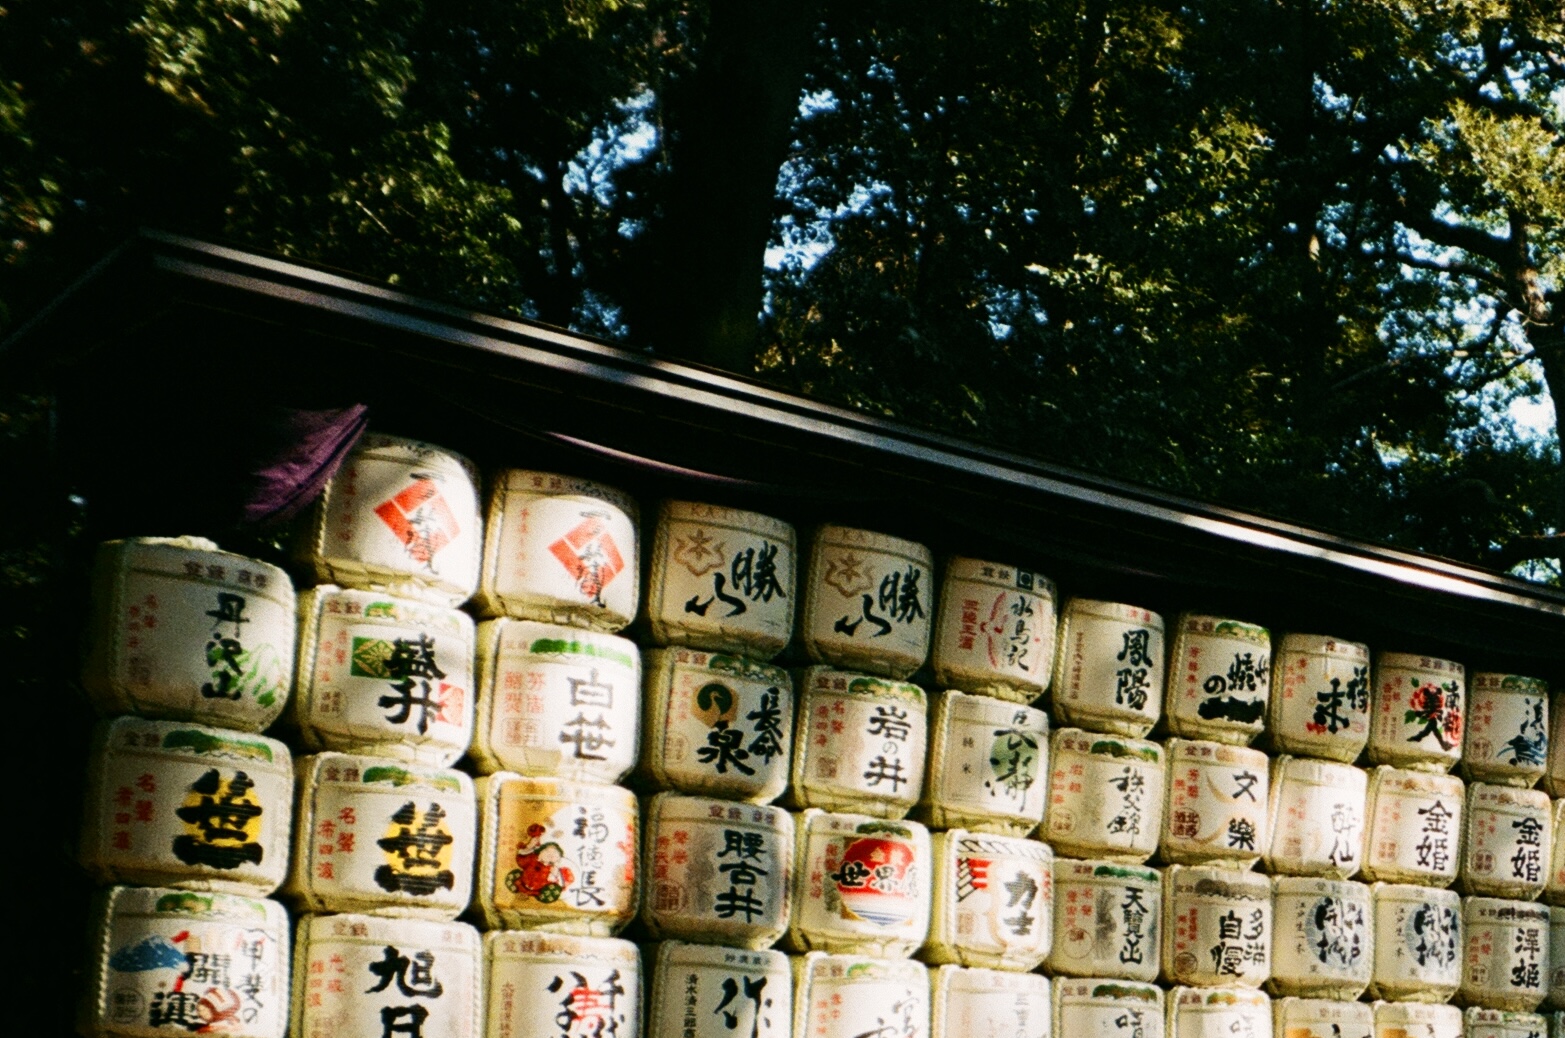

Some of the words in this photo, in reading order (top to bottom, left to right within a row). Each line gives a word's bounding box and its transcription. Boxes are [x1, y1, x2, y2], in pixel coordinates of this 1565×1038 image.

[684, 540, 786, 618] 勝山
[833, 564, 927, 638] 勝山
[200, 591, 251, 702] 丹沢山
[377, 633, 447, 735] 盛升
[1114, 628, 1154, 711] 鳳陽
[697, 685, 785, 777] 長命泉
[863, 705, 912, 794] 岩の井
[1107, 765, 1147, 849] 秩父錦
[1414, 799, 1454, 872] 金婚
[714, 829, 770, 924] 腰古井
[831, 858, 918, 898] 世界
[1510, 816, 1544, 883] 金婚
[1003, 868, 1039, 937] 力士
[1510, 926, 1542, 989] 澤姫
